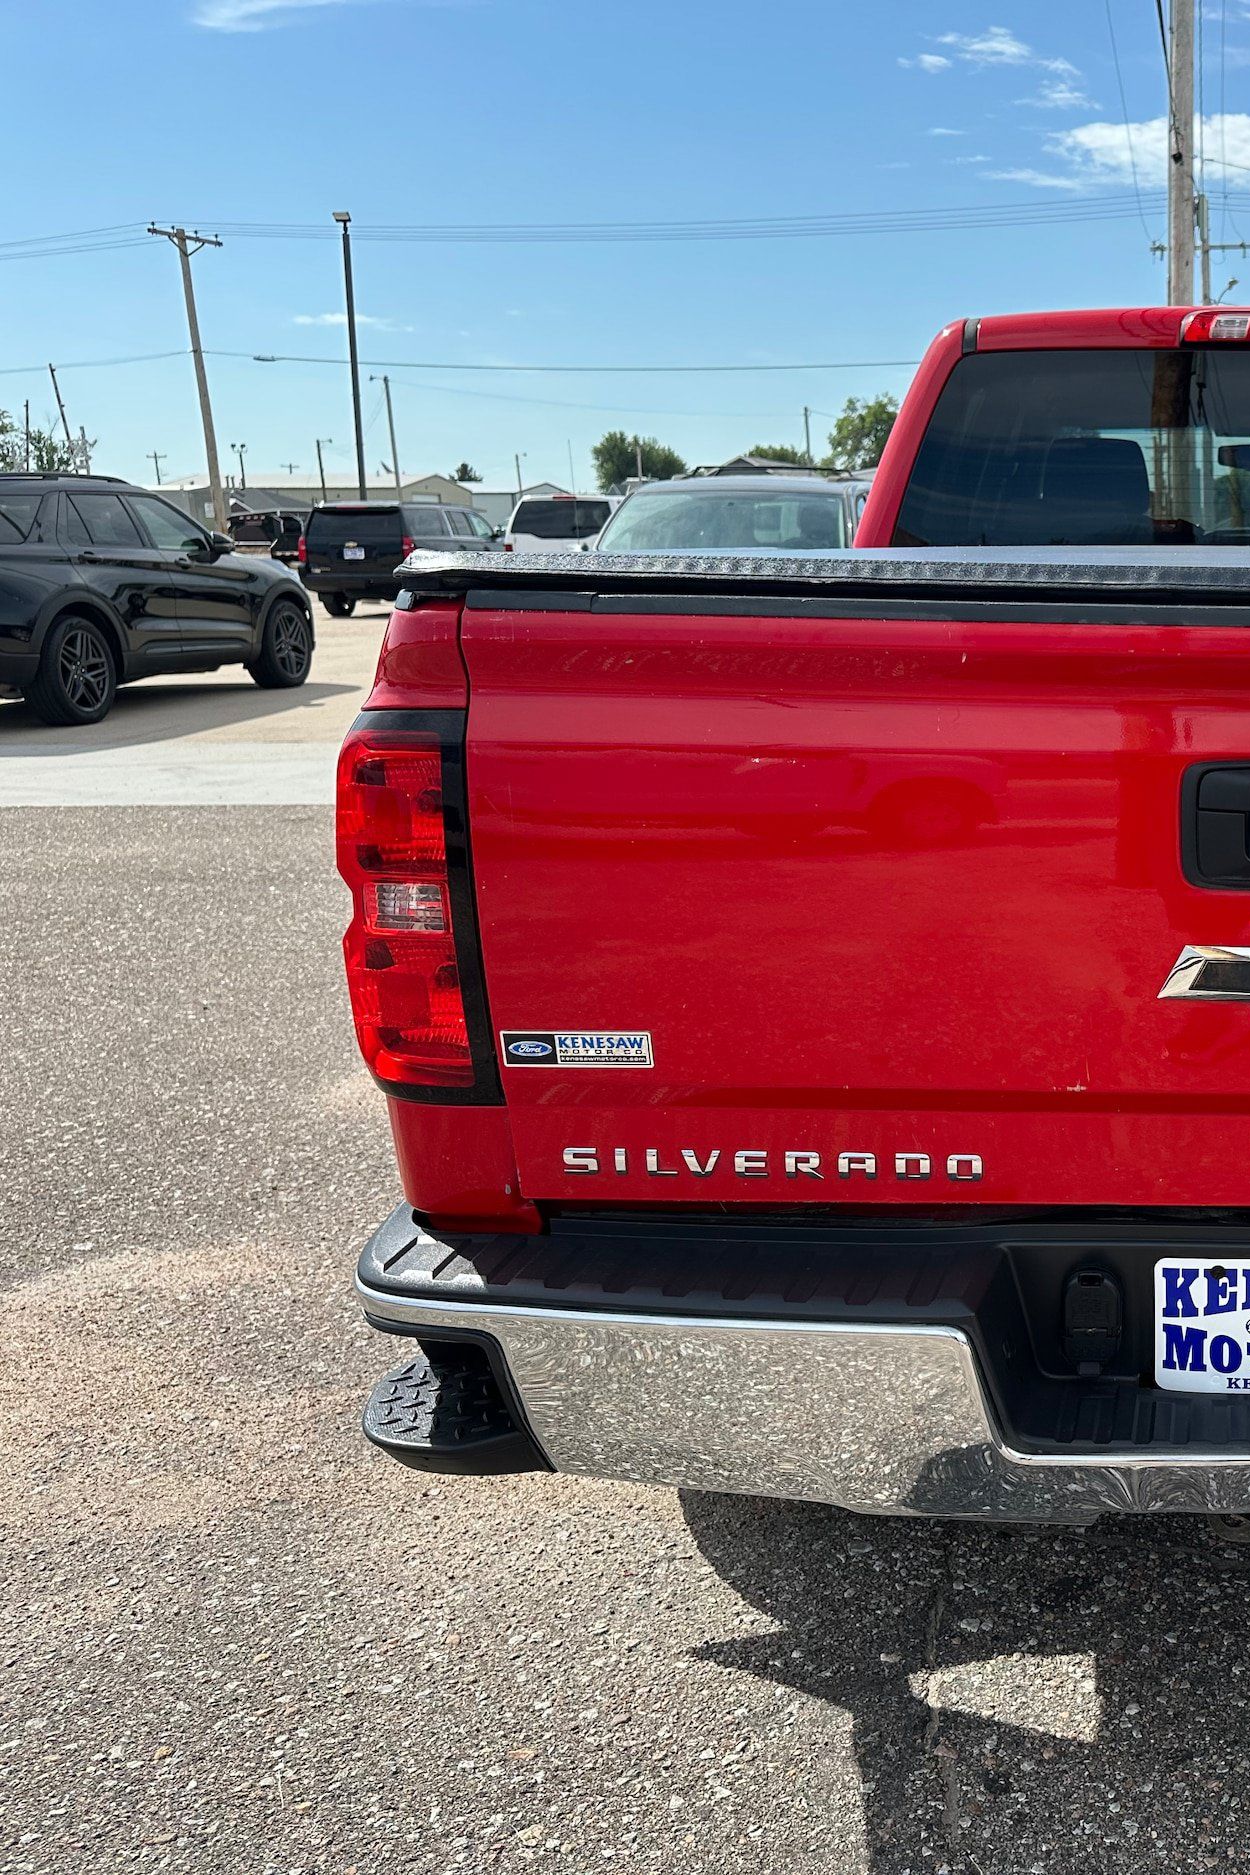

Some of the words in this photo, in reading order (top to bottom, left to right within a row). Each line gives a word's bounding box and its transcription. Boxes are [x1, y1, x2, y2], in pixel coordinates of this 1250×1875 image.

[518, 1043, 542, 1054] Ford
[557, 1036, 644, 1049] KENESAW
[562, 1147, 985, 1182] SILVERADO
